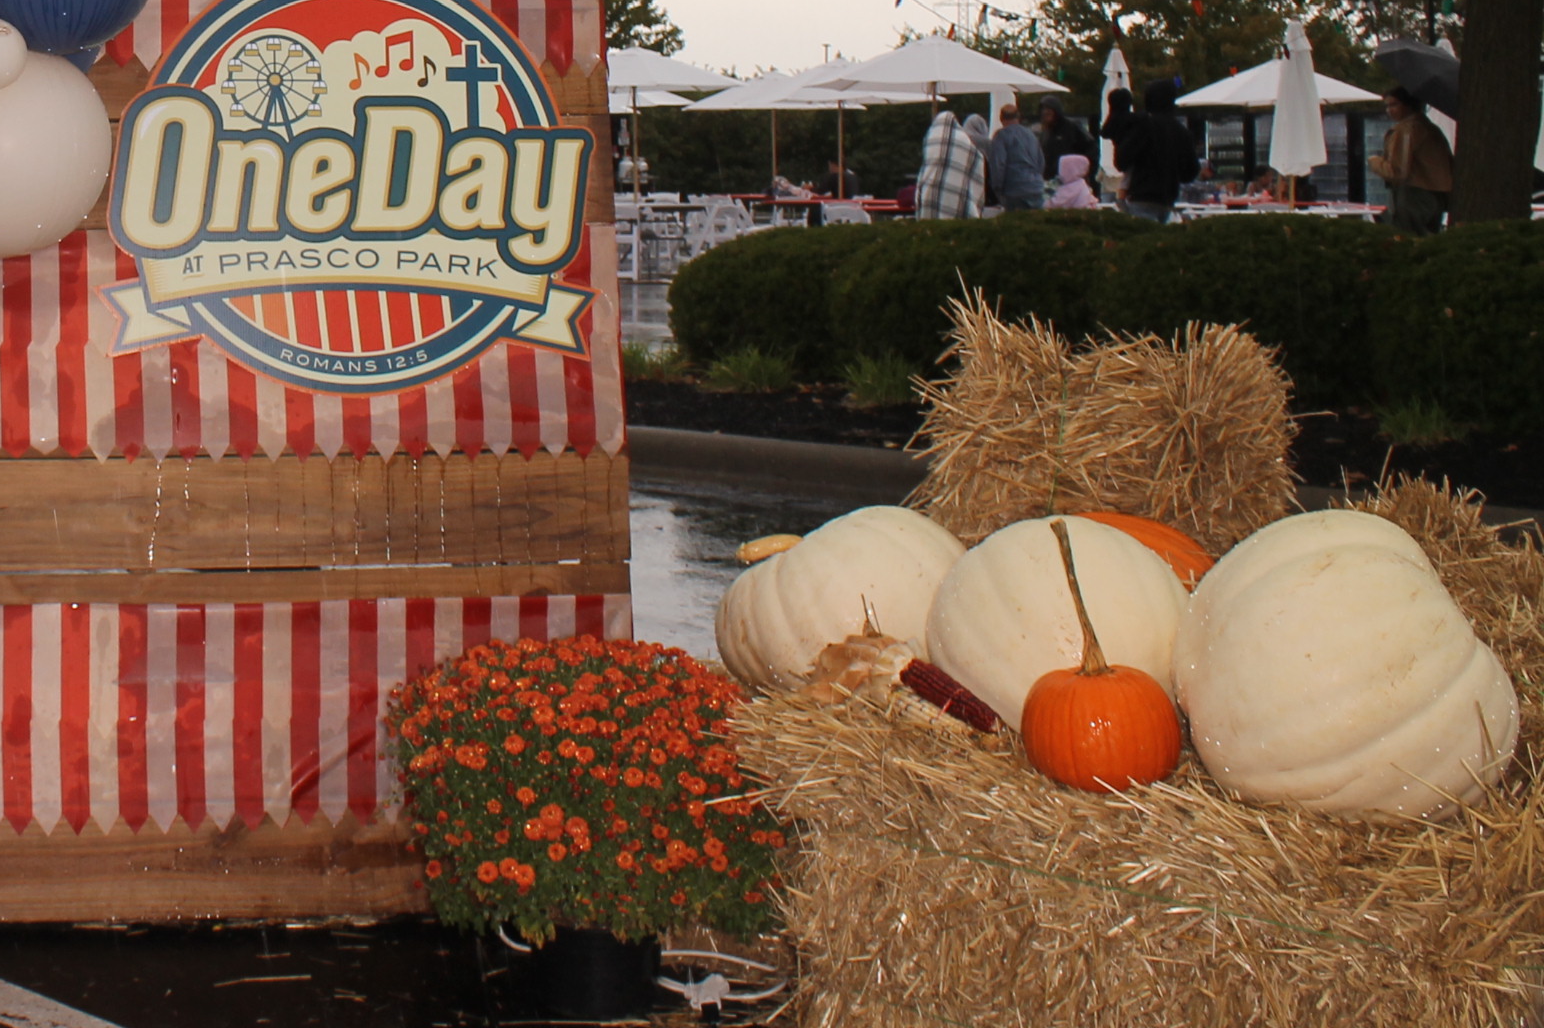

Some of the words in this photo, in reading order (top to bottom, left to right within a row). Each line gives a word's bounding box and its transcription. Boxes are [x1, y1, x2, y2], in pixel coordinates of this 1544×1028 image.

[182, 255, 204, 275] AT
[219, 248, 380, 274] PRASCO
[397, 250, 498, 279] PARK
[280, 348, 377, 373] ROMANS
[387, 349, 429, 370] 12:5
